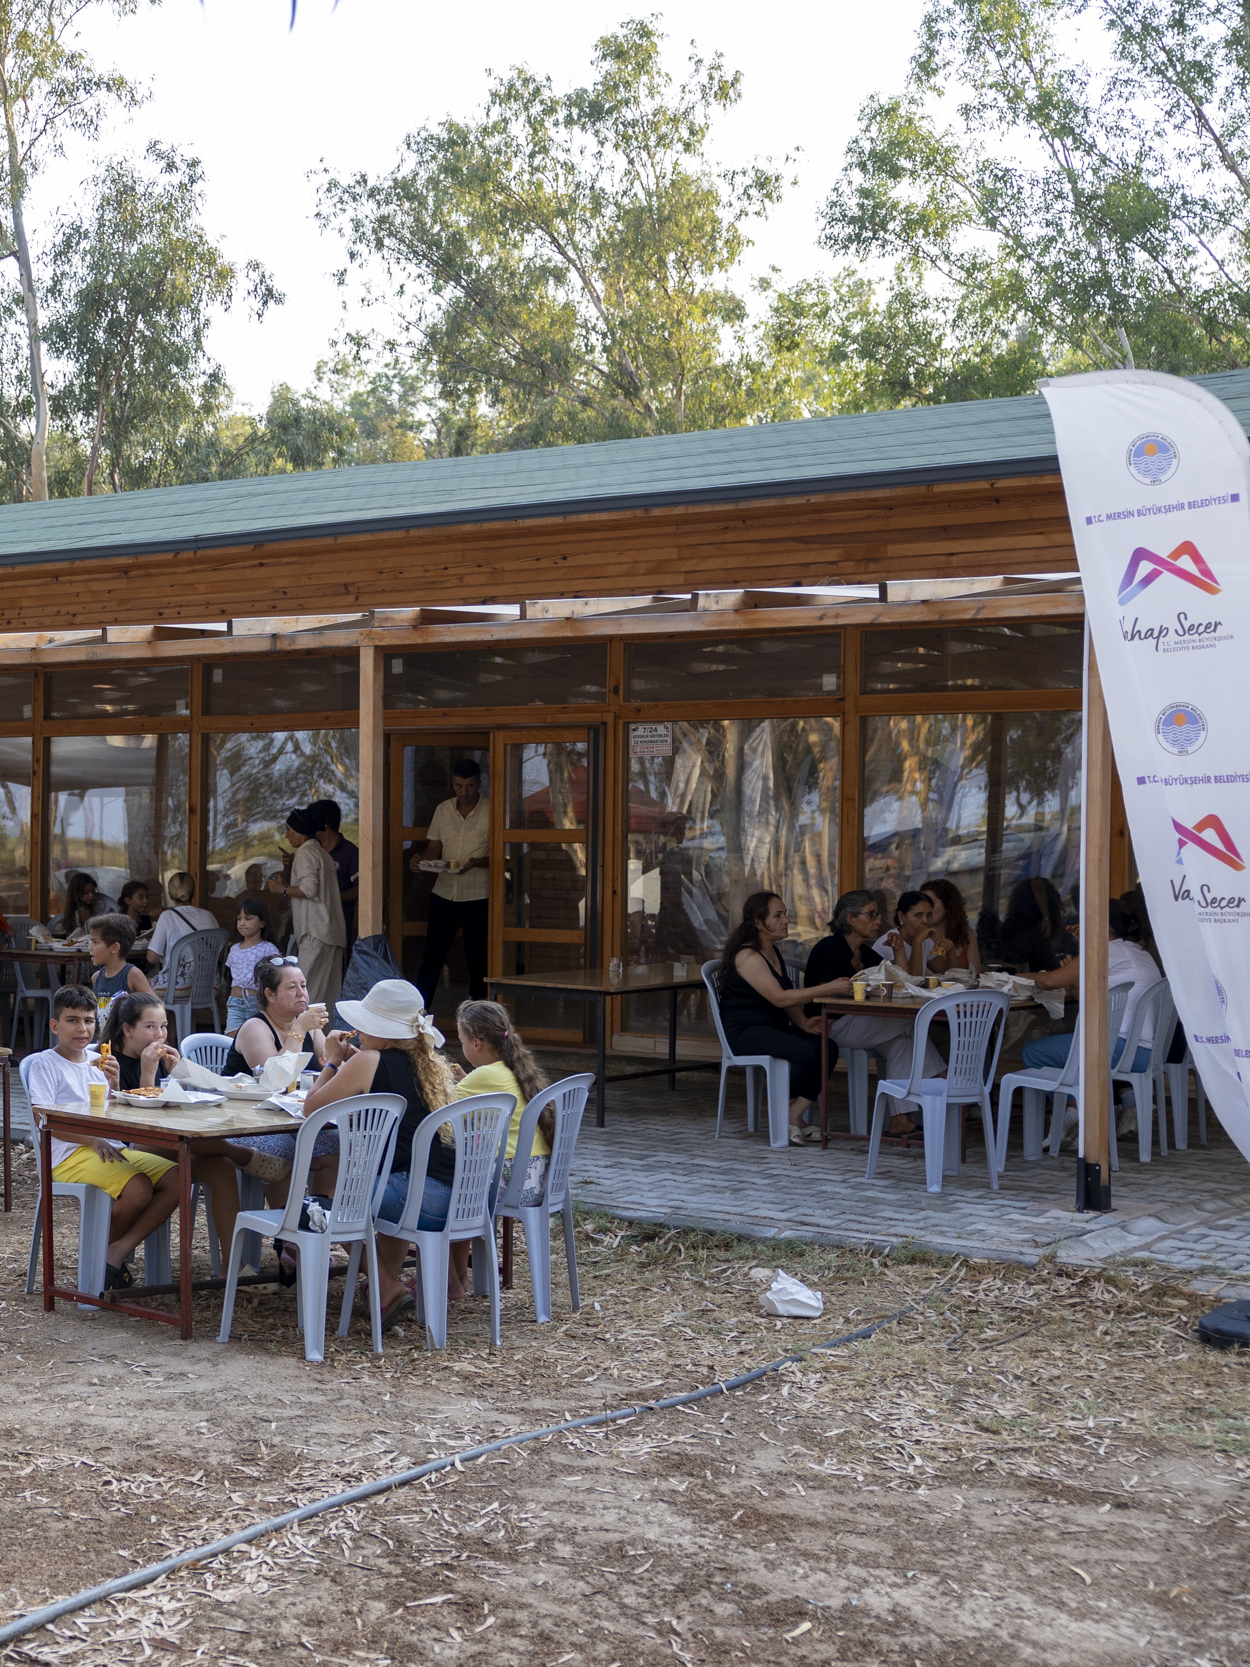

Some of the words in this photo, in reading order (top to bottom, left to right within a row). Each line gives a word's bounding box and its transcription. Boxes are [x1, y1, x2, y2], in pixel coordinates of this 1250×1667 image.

[1093, 514, 1104, 523] T.C.
[1106, 508, 1135, 521] MERSİN
[1136, 500, 1186, 517] BÜYÜKŞEHİR
[1187, 493, 1229, 510] BELEDİYESİ
[1174, 611, 1223, 637] Seçer
[1173, 638, 1197, 646] MERSİN
[1198, 634, 1235, 643] BÜYÜKŞEHİR
[1162, 644, 1190, 653] BELEDİYE
[1191, 642, 1217, 651] BAŞKANI
[1147, 774, 1159, 784] T.C.
[1164, 774, 1212, 787] BÜYÜKŞEHİR
[1197, 884, 1246, 911] Seçer
[1220, 910, 1250, 918] BÜYÜKŞEH
